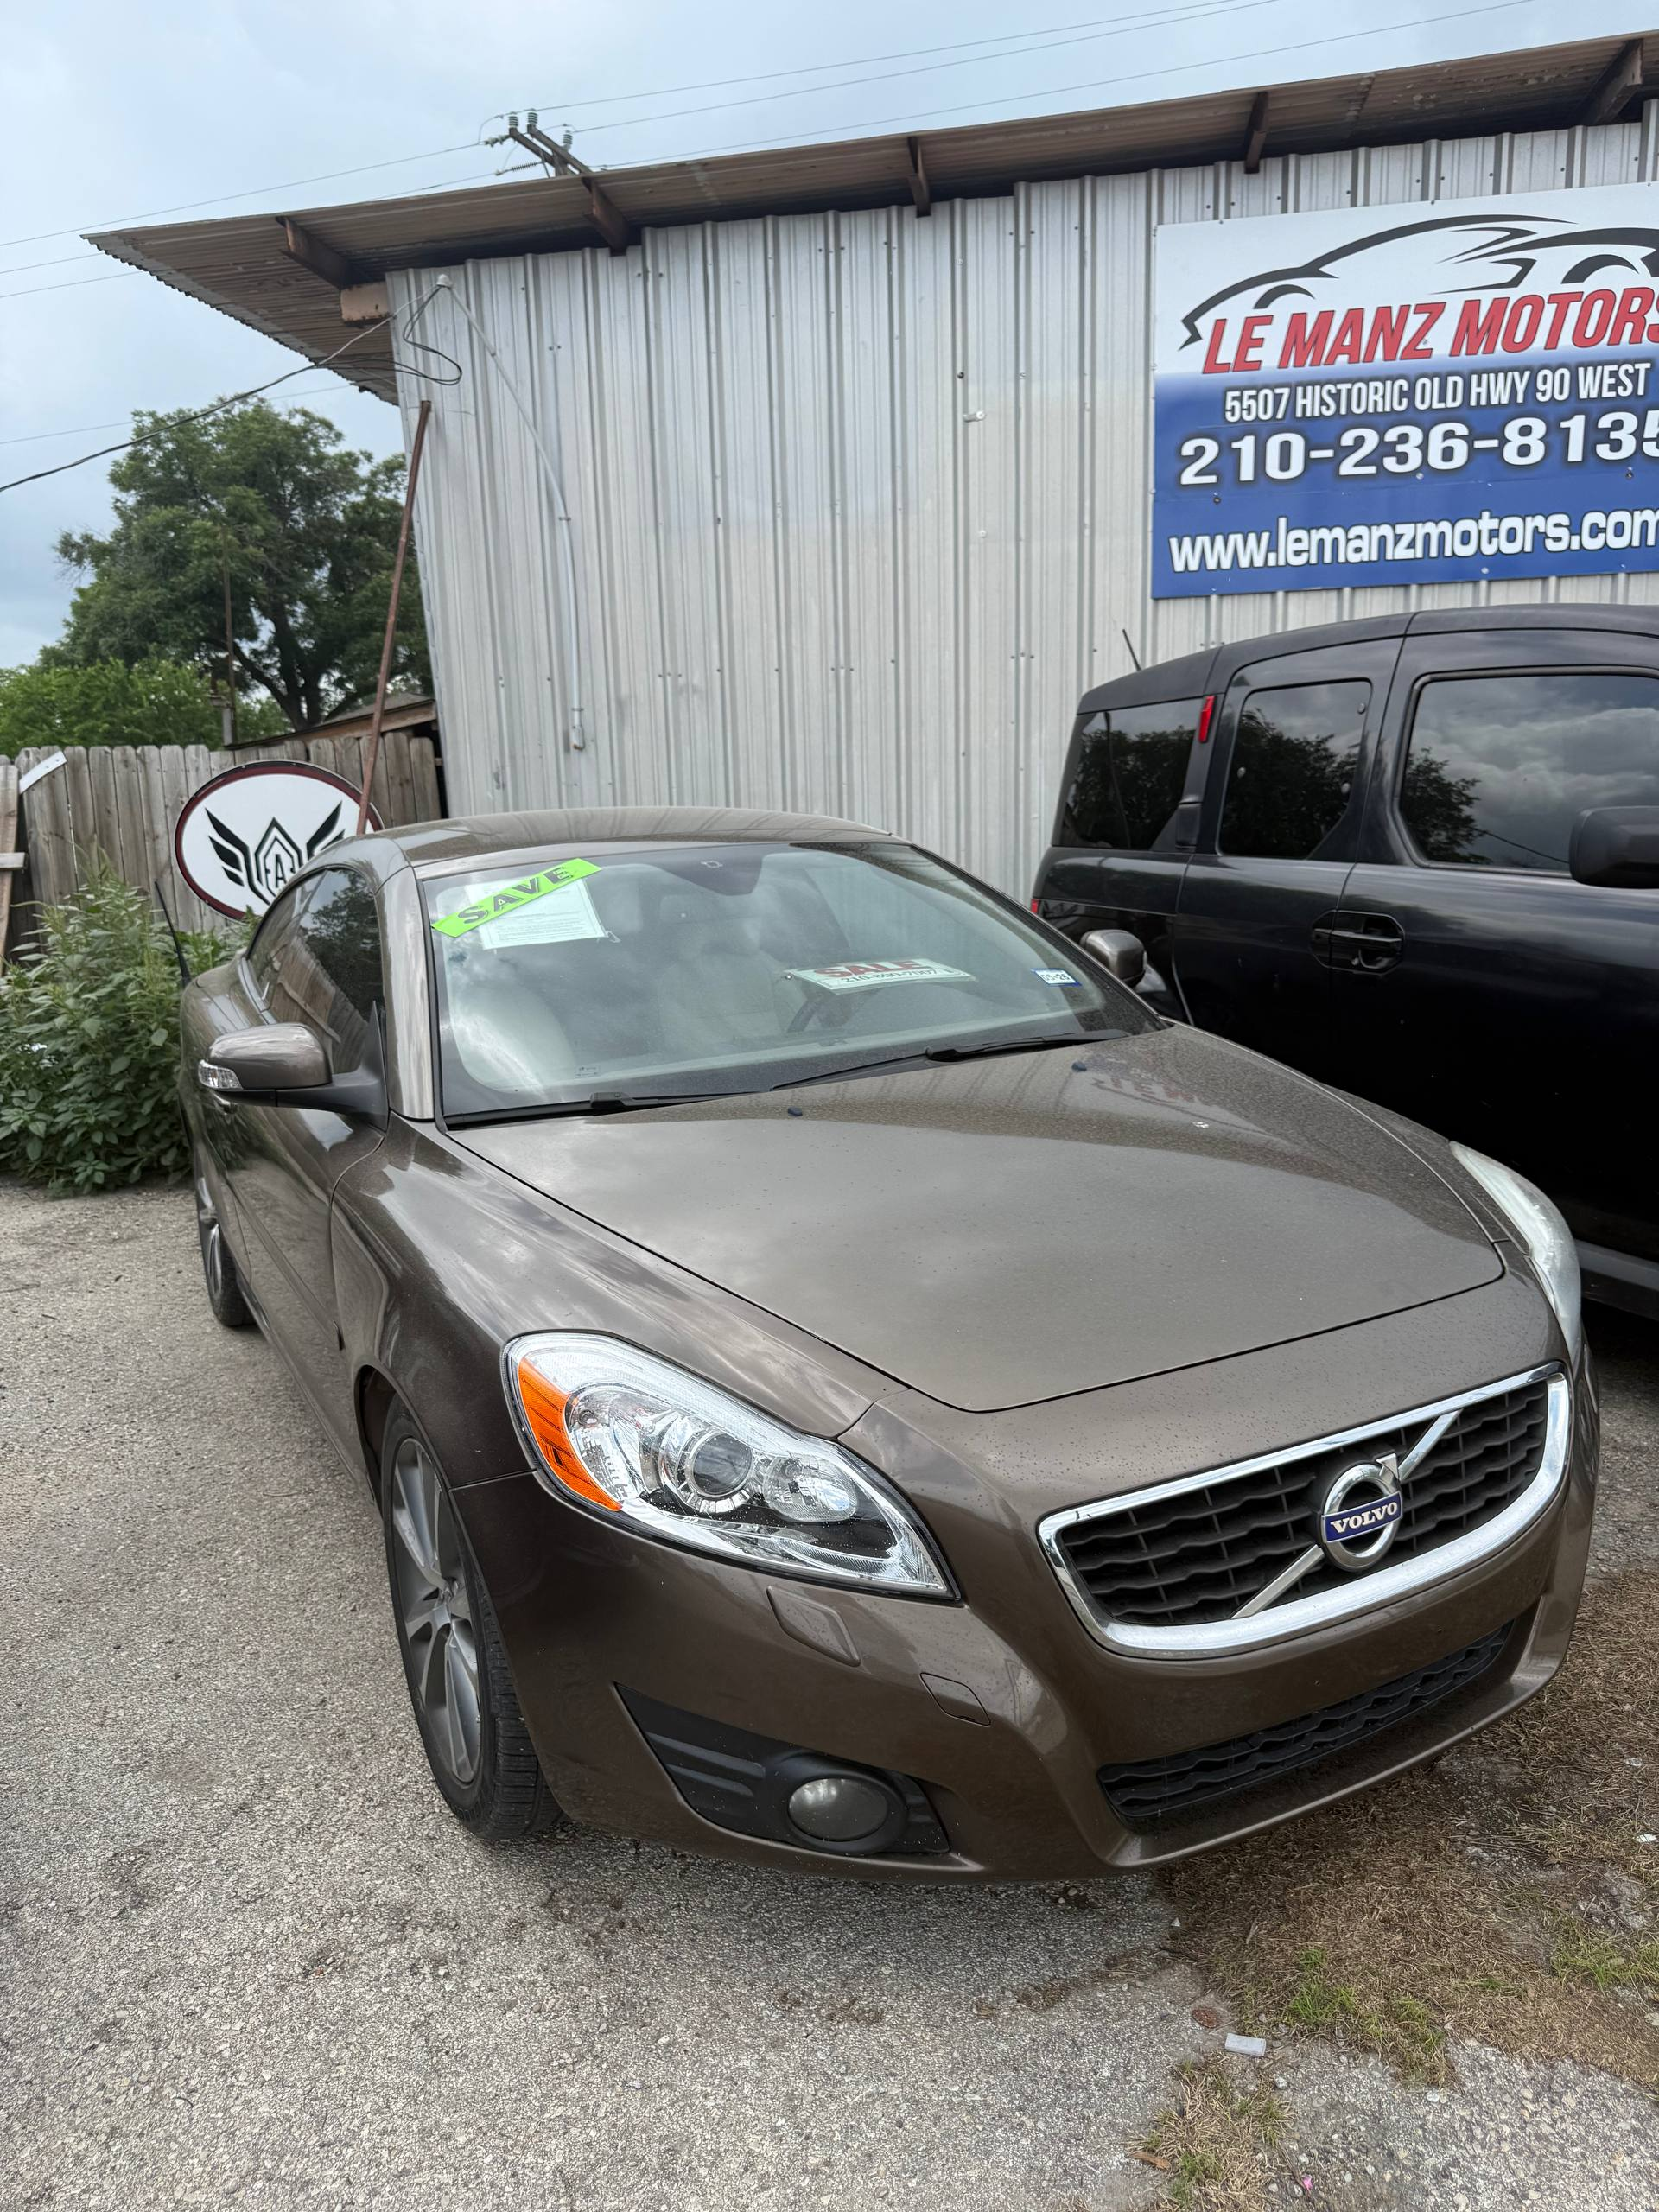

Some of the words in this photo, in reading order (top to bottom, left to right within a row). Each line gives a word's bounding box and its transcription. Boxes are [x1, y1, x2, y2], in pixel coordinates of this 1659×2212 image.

[1202, 315, 1274, 374] LE
[1277, 302, 1446, 369] MANZ
[1224, 387, 1291, 423] 5507
[1296, 378, 1408, 418] HISTORIC
[1414, 374, 1463, 410] OLD
[1469, 370, 1531, 406] HWY
[1535, 367, 1571, 402] 90
[1577, 362, 1651, 400] WEST
[1168, 508, 1659, 574] www.lemanzmotors.com
[457, 866, 575, 925] SAVE
[813, 959, 933, 978] SALE
[1330, 1501, 1398, 1534] VOLVO
